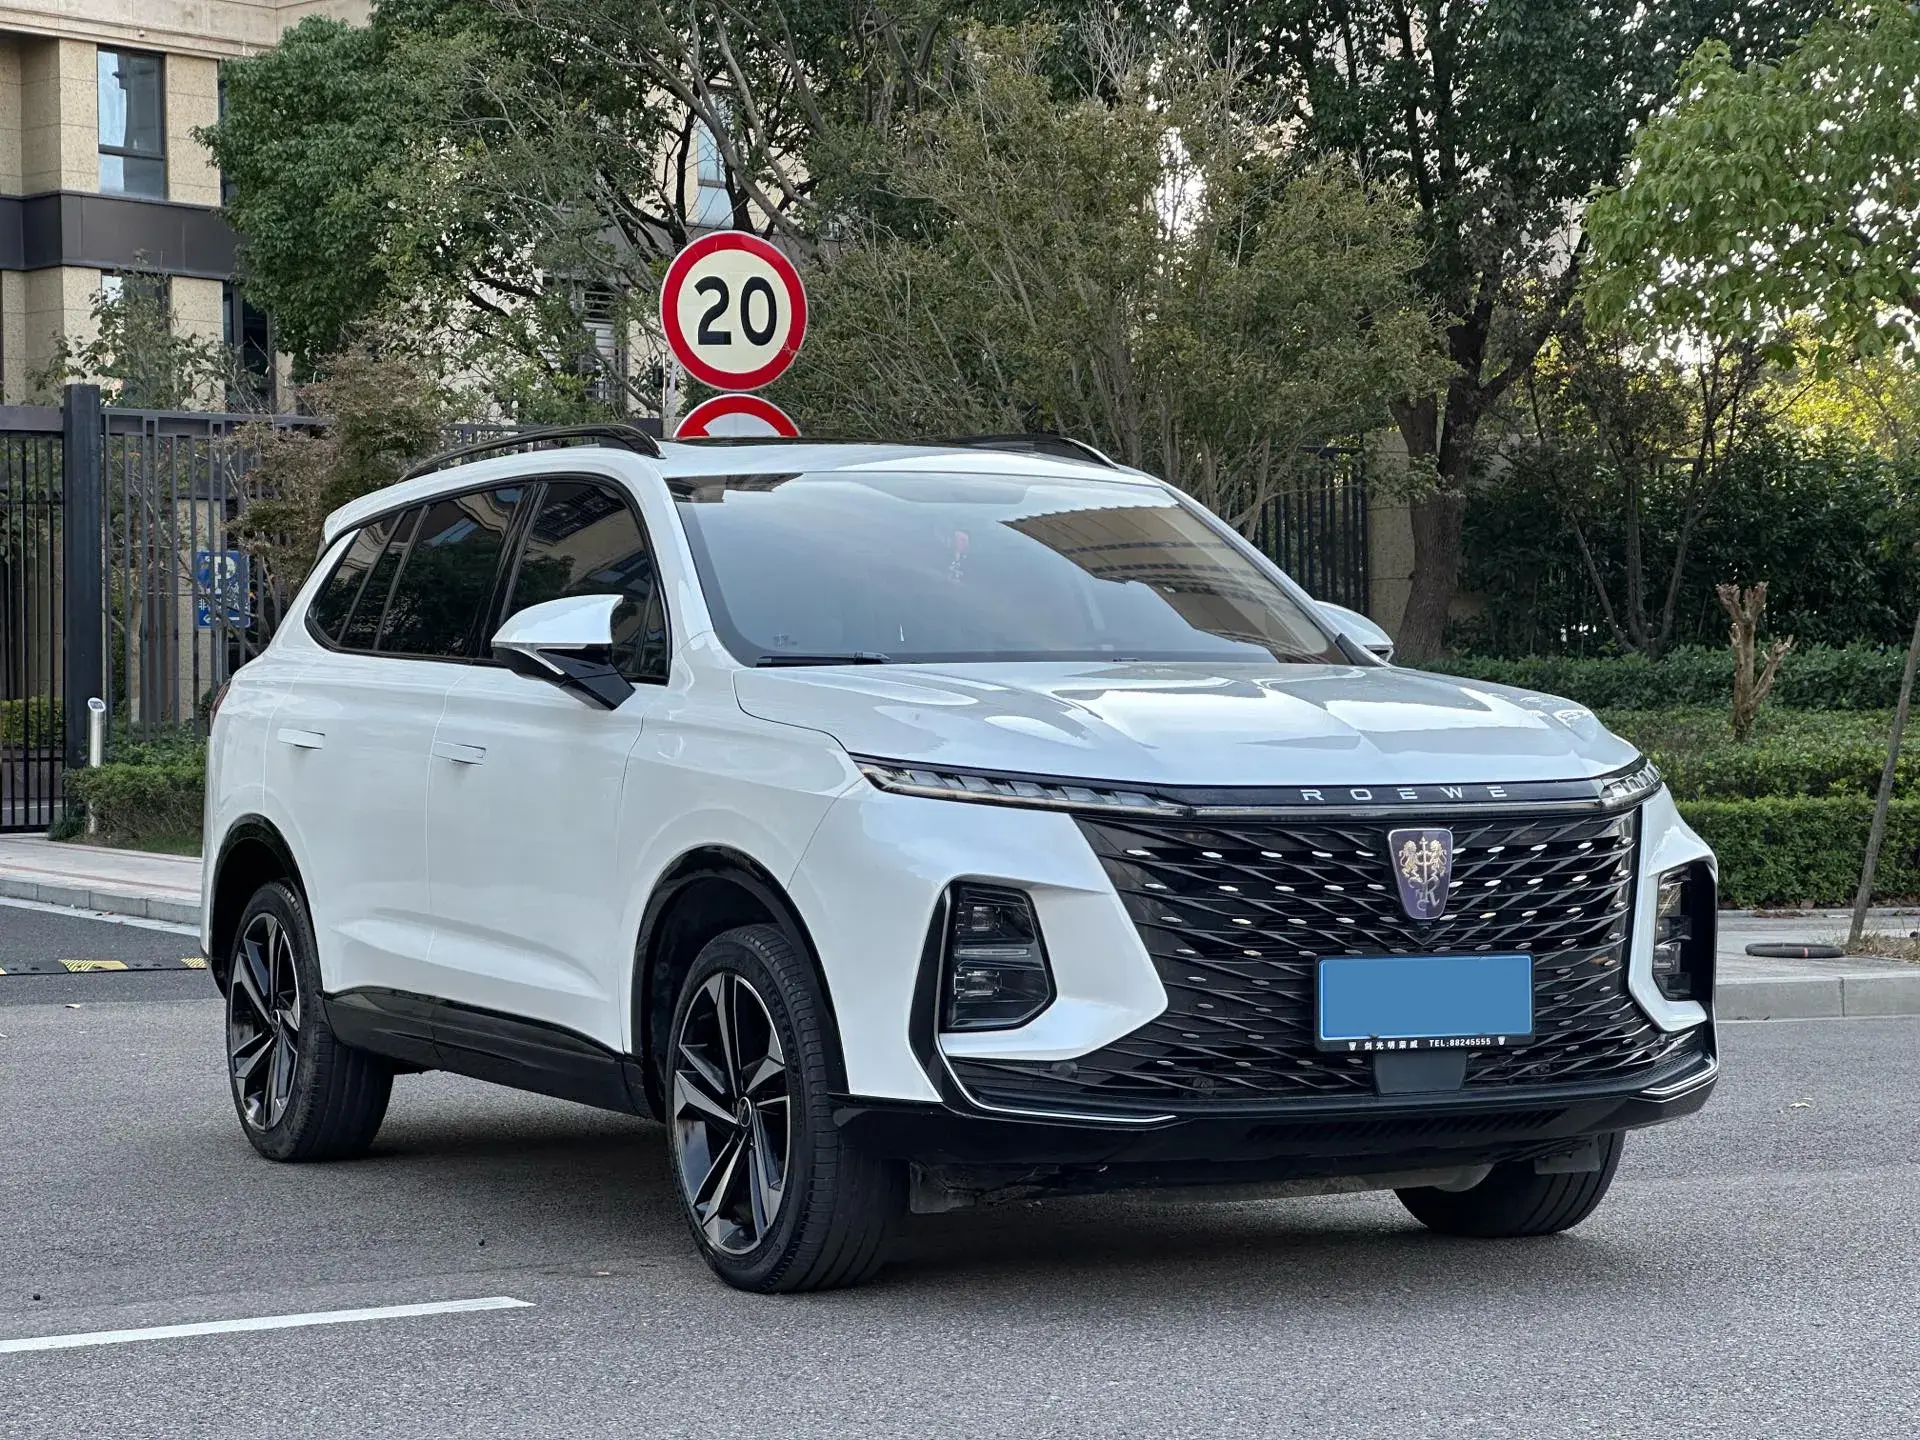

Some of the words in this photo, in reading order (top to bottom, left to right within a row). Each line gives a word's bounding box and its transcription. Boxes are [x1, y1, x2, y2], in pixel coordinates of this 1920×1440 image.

[694, 275, 778, 347] 20
[1300, 785, 1507, 801] ROEWE
[1429, 1037, 1491, 1048] TEL:88245555
